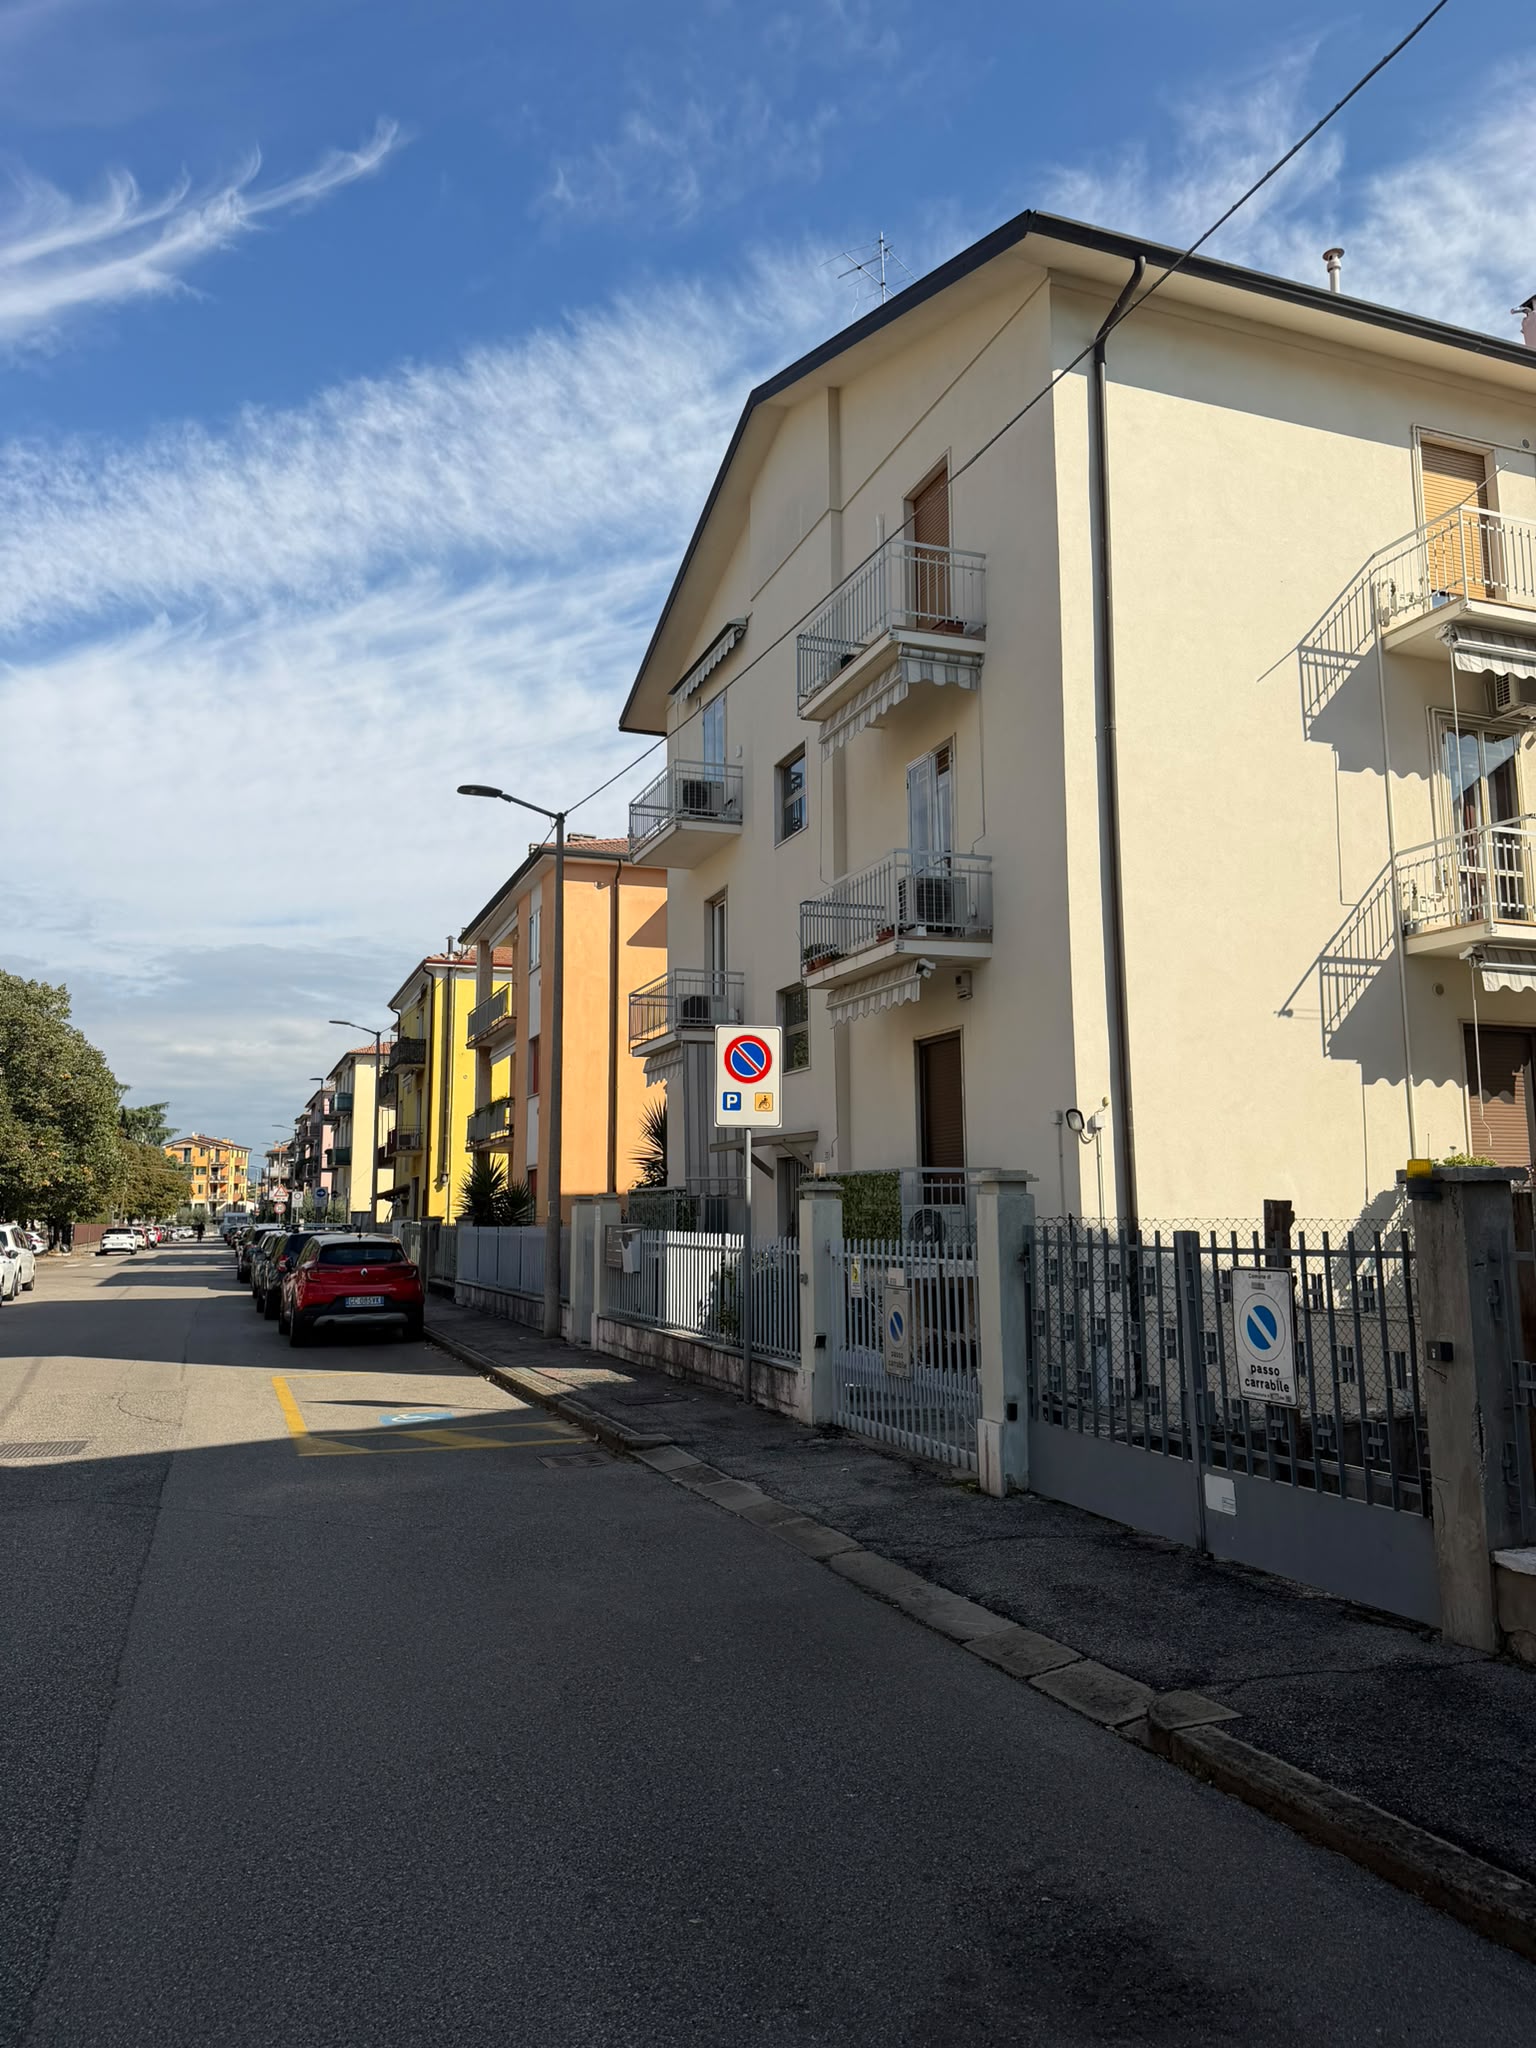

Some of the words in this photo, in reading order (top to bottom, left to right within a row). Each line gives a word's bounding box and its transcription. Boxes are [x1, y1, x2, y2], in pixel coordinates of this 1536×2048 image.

[726, 1094, 738, 1109] P
[1250, 1364, 1280, 1376] passo
[1245, 1378, 1290, 1392] carrabile
